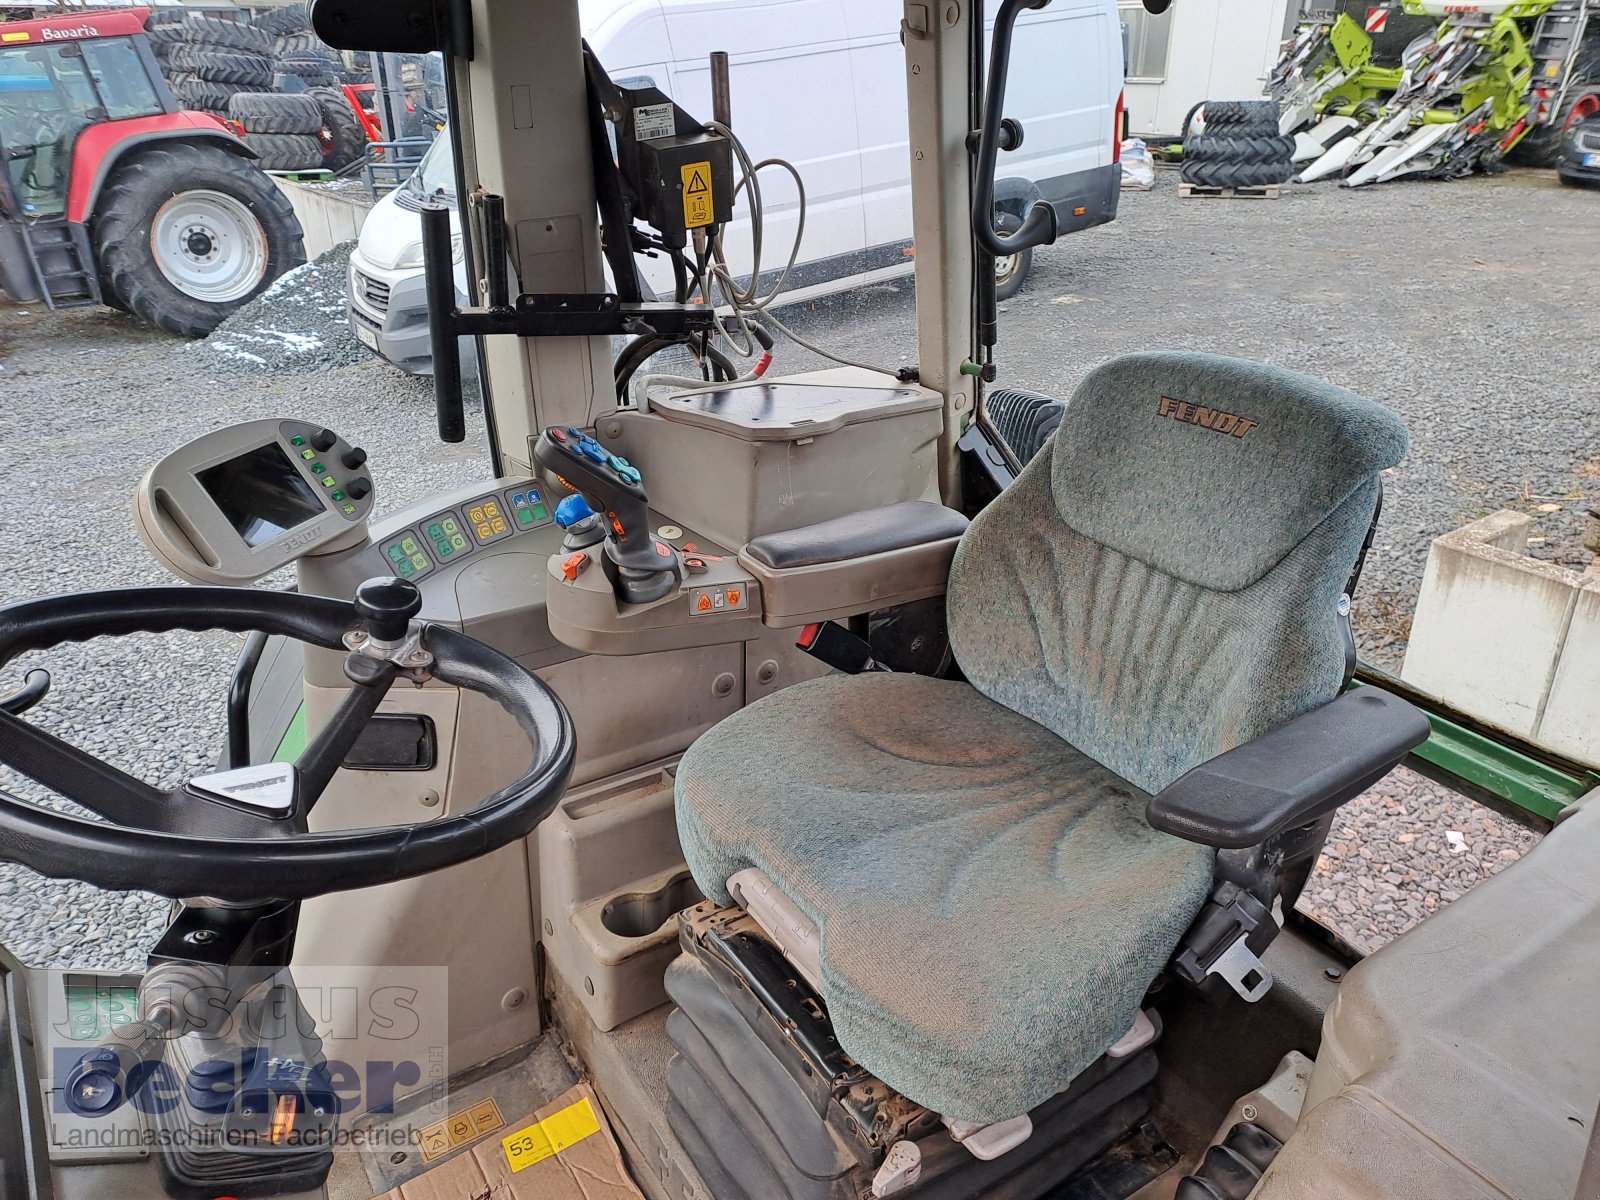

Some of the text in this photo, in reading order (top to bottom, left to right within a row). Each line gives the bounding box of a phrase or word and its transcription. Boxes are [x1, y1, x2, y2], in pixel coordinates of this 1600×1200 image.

[41, 24, 99, 40] Bavaria
[1157, 395, 1260, 439] FENDT
[509, 1136, 534, 1156] 53
